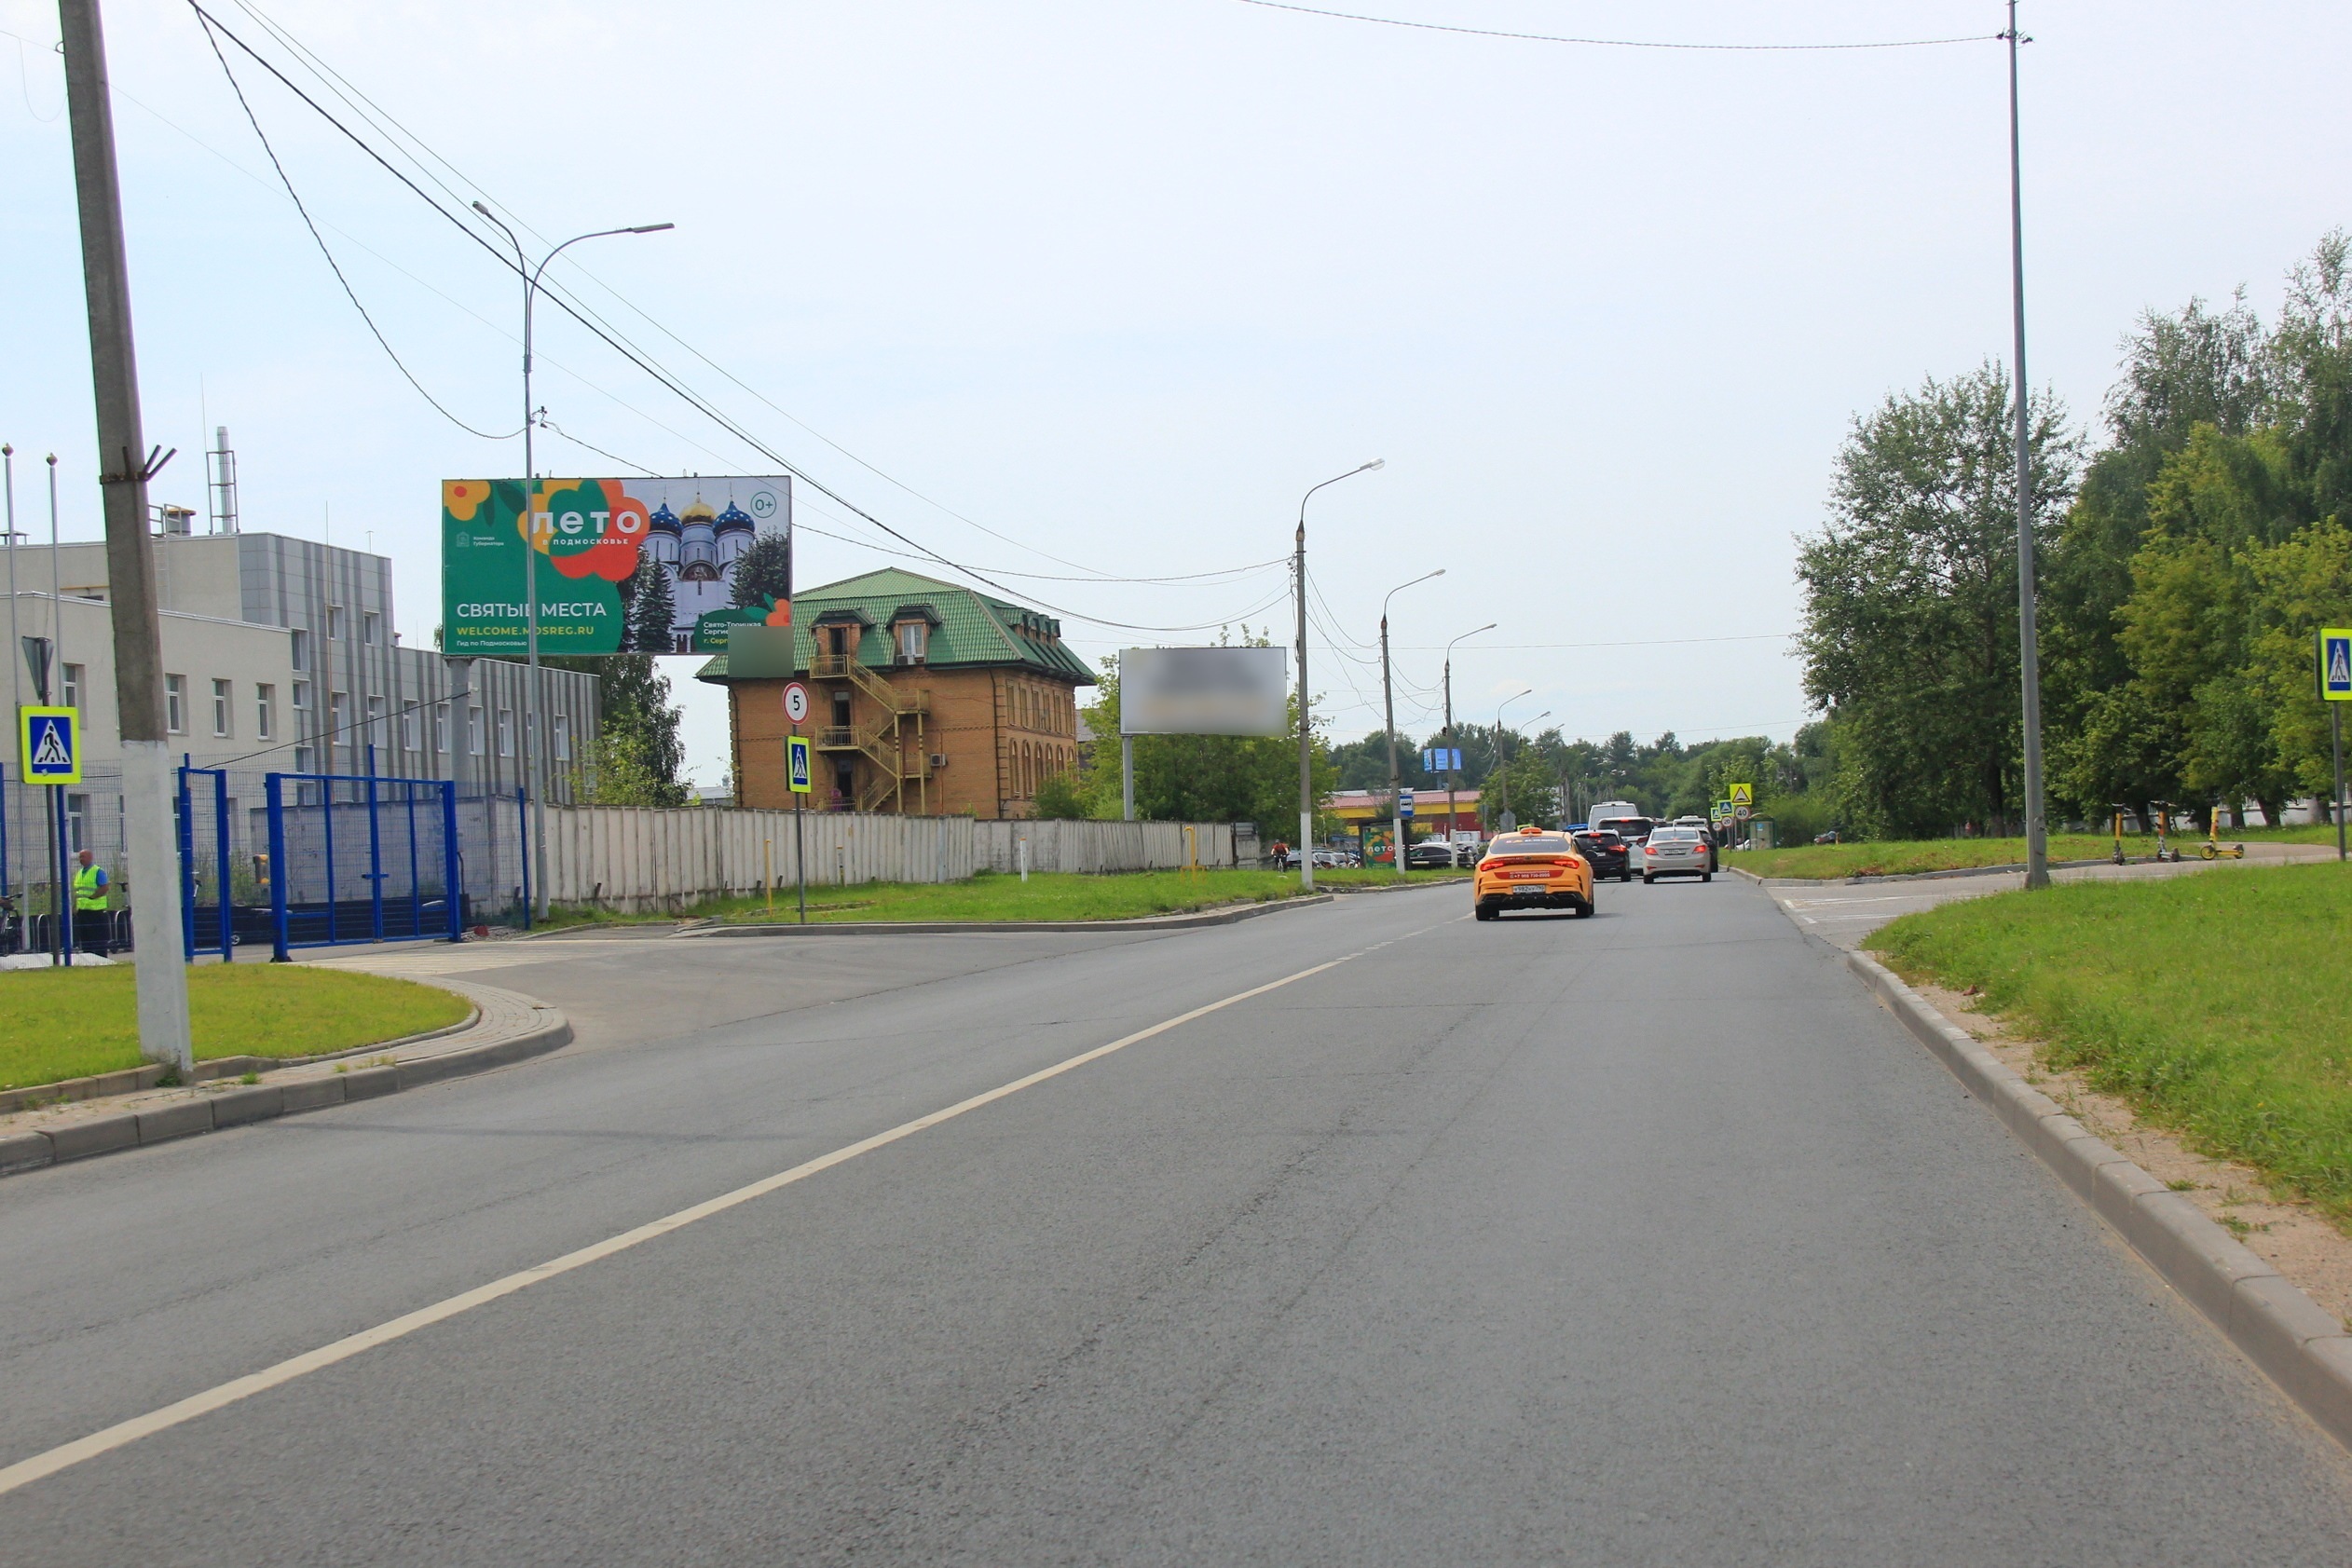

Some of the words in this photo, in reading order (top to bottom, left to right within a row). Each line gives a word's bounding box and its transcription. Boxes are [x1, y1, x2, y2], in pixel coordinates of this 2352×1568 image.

[755, 498, 773, 511] 0+
[541, 603, 607, 617] МЕСТА
[457, 626, 595, 635] WELCOME.MOSREG.RU
[793, 695, 800, 711] 5
